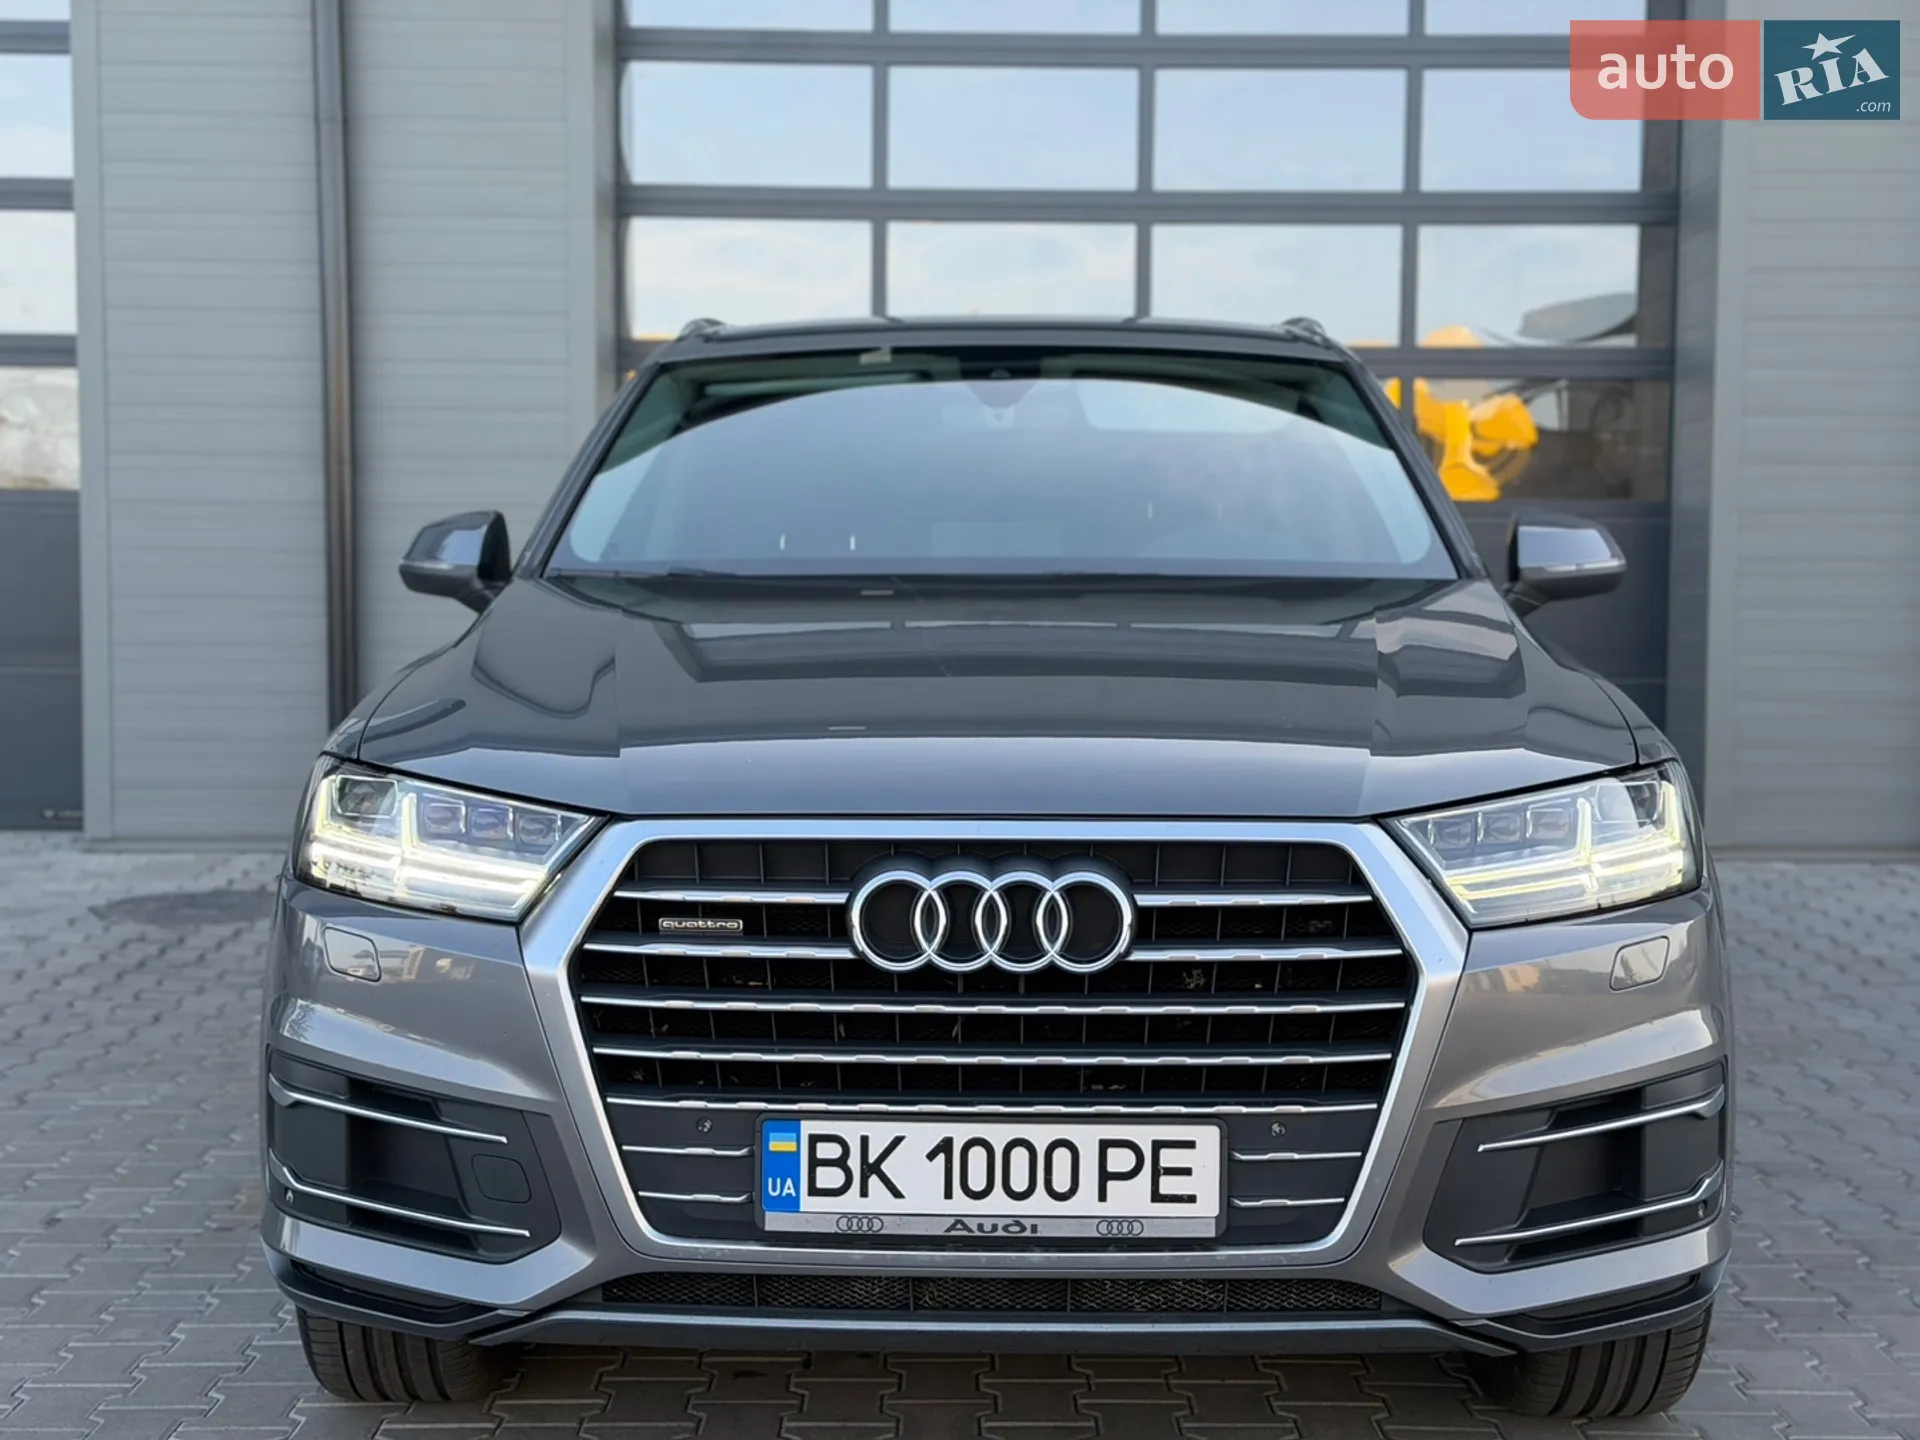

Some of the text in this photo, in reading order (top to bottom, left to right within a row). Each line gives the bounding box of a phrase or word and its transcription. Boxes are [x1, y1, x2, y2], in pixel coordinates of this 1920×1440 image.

[662, 920, 739, 929] quattro
[807, 1133, 1197, 1204] BK 1000 PE
[767, 1177, 796, 1197] UA
[943, 1219, 1039, 1236] Audi
